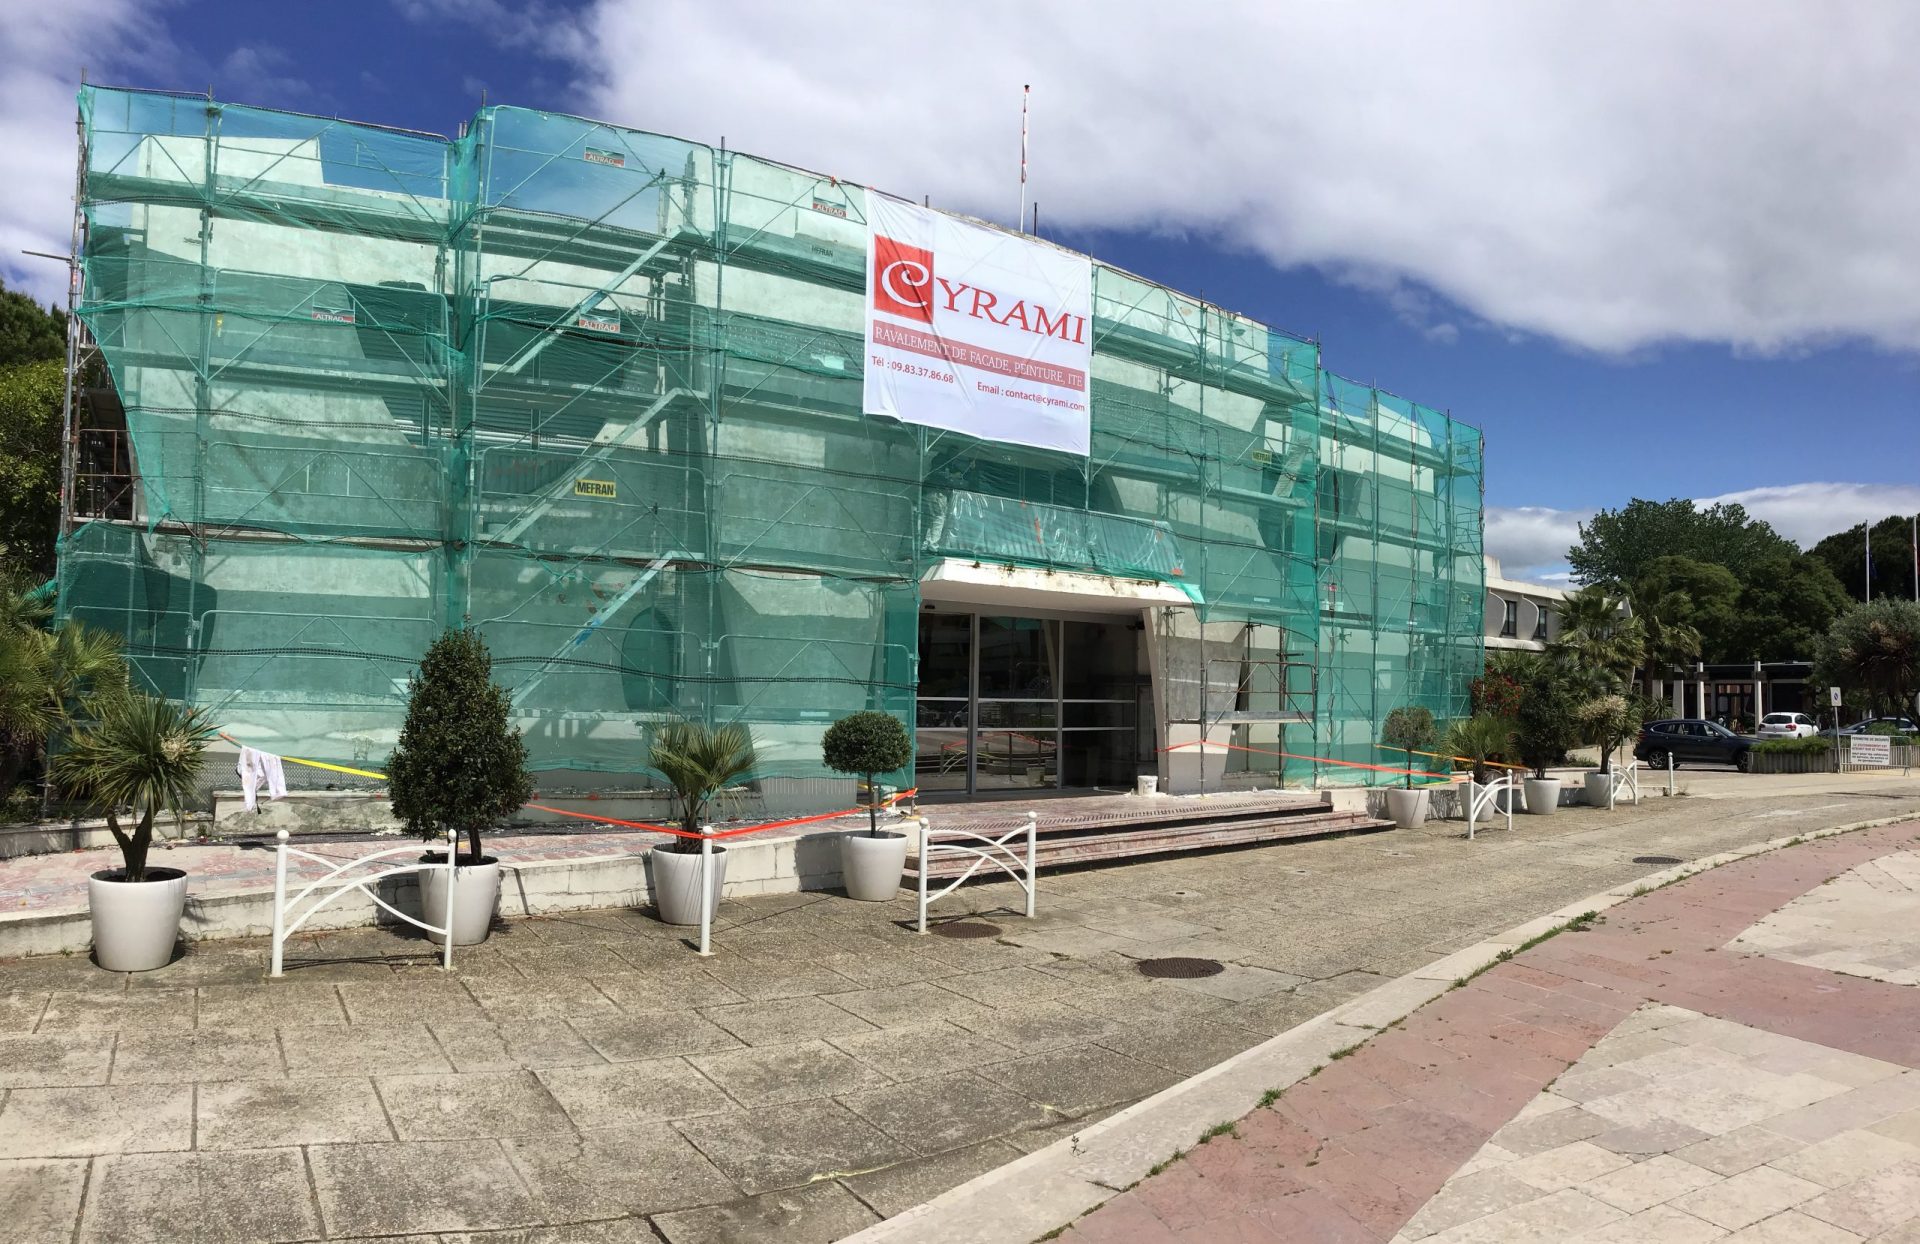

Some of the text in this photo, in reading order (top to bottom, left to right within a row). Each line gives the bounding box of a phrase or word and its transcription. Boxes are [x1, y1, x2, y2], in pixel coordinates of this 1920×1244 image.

[881, 260, 1086, 345] CYRAMI
[875, 326, 950, 356] RAVALEMENT
[952, 346, 967, 361] DE
[1014, 362, 1065, 385] PEINTURE,
[1068, 373, 1083, 387] ITE
[891, 361, 954, 384] 09.83.37.86.68
[977, 381, 1000, 395] Email
[1005, 389, 1085, 412] contact@cyrami.com
[577, 481, 614, 496] MEFRAN
